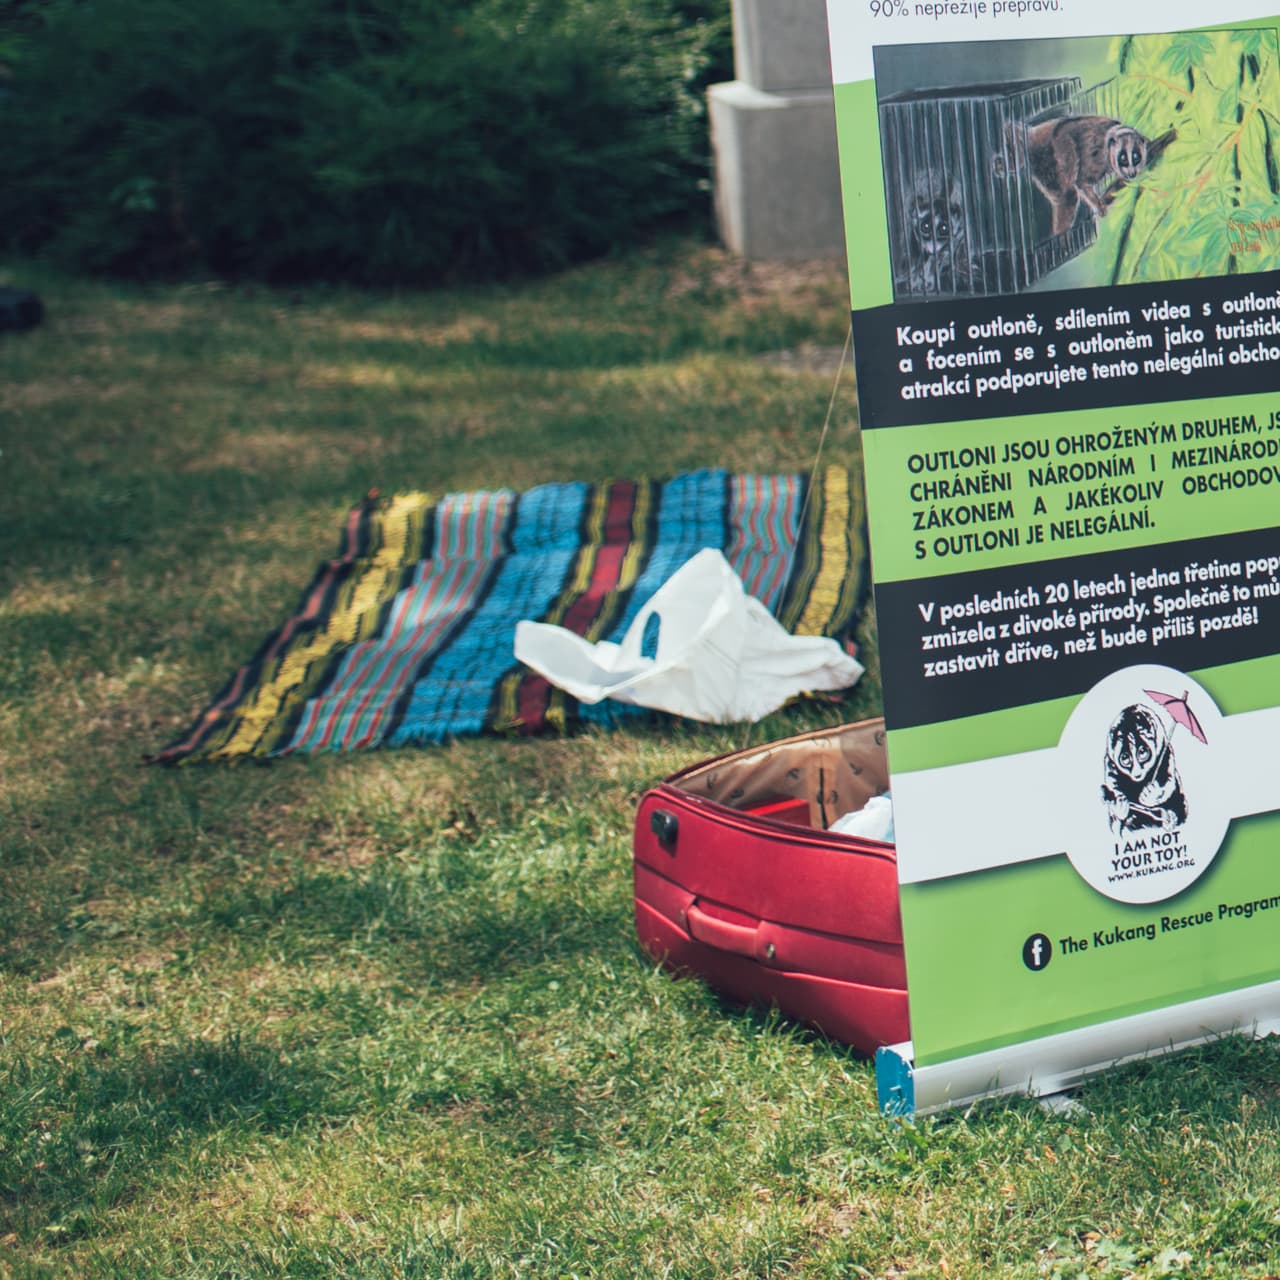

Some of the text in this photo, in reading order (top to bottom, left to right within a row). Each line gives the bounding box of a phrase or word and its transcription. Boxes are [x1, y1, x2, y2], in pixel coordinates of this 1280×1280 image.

[897, 321, 955, 348] Koupí
[968, 313, 1043, 339] outloně,
[1055, 306, 1130, 331] sdílením
[1141, 300, 1191, 322] videa
[1203, 303, 1211, 316] s
[899, 358, 913, 373] a
[926, 345, 1001, 370] focením
[1014, 346, 1034, 361] se
[1047, 344, 1056, 358] s
[1068, 330, 1153, 355] outloněm
[1164, 324, 1204, 351] jako
[901, 373, 970, 400] atrakcí
[976, 364, 1087, 397] podporujete
[1092, 360, 1139, 379] tento
[1144, 347, 1224, 375] nelegální
[907, 445, 996, 474] OUTLONI
[1002, 439, 1050, 463] JSOU
[1056, 421, 1177, 456] OHROŽENÝM
[1182, 414, 1262, 441] DRUHEM,
[910, 469, 1012, 502] CHRÁNĚNI
[1028, 454, 1135, 487] NÁRODNÍM
[1150, 454, 1156, 472] I
[913, 500, 1014, 531] ZÁKONEM
[1033, 496, 1047, 515] A
[1065, 480, 1164, 511] JAKÉKOLIV
[915, 505, 1155, 560] S OUTLONI JE NELEGÁLNÍ.
[918, 602, 934, 622] V
[940, 586, 1040, 626] posledních
[1045, 583, 1069, 604] 20
[1073, 573, 1126, 600] letech
[1130, 568, 1180, 596] jedna
[1184, 559, 1241, 583] třetina
[922, 621, 996, 650] zmizela
[999, 624, 1010, 638] z
[1013, 608, 1076, 636] divoké
[1079, 598, 1150, 631] přírody.
[1153, 584, 1230, 618] Společně
[1232, 585, 1250, 601] to
[924, 606, 1258, 677] zastavit dříve, než bude příliš pozdě!
[1111, 844, 1187, 871] YOUR TOY!
[1114, 831, 1181, 856] I AM NOT
[1059, 936, 1088, 955] The
[1093, 924, 1156, 948] Kukang
[1161, 911, 1213, 933] Rescue
